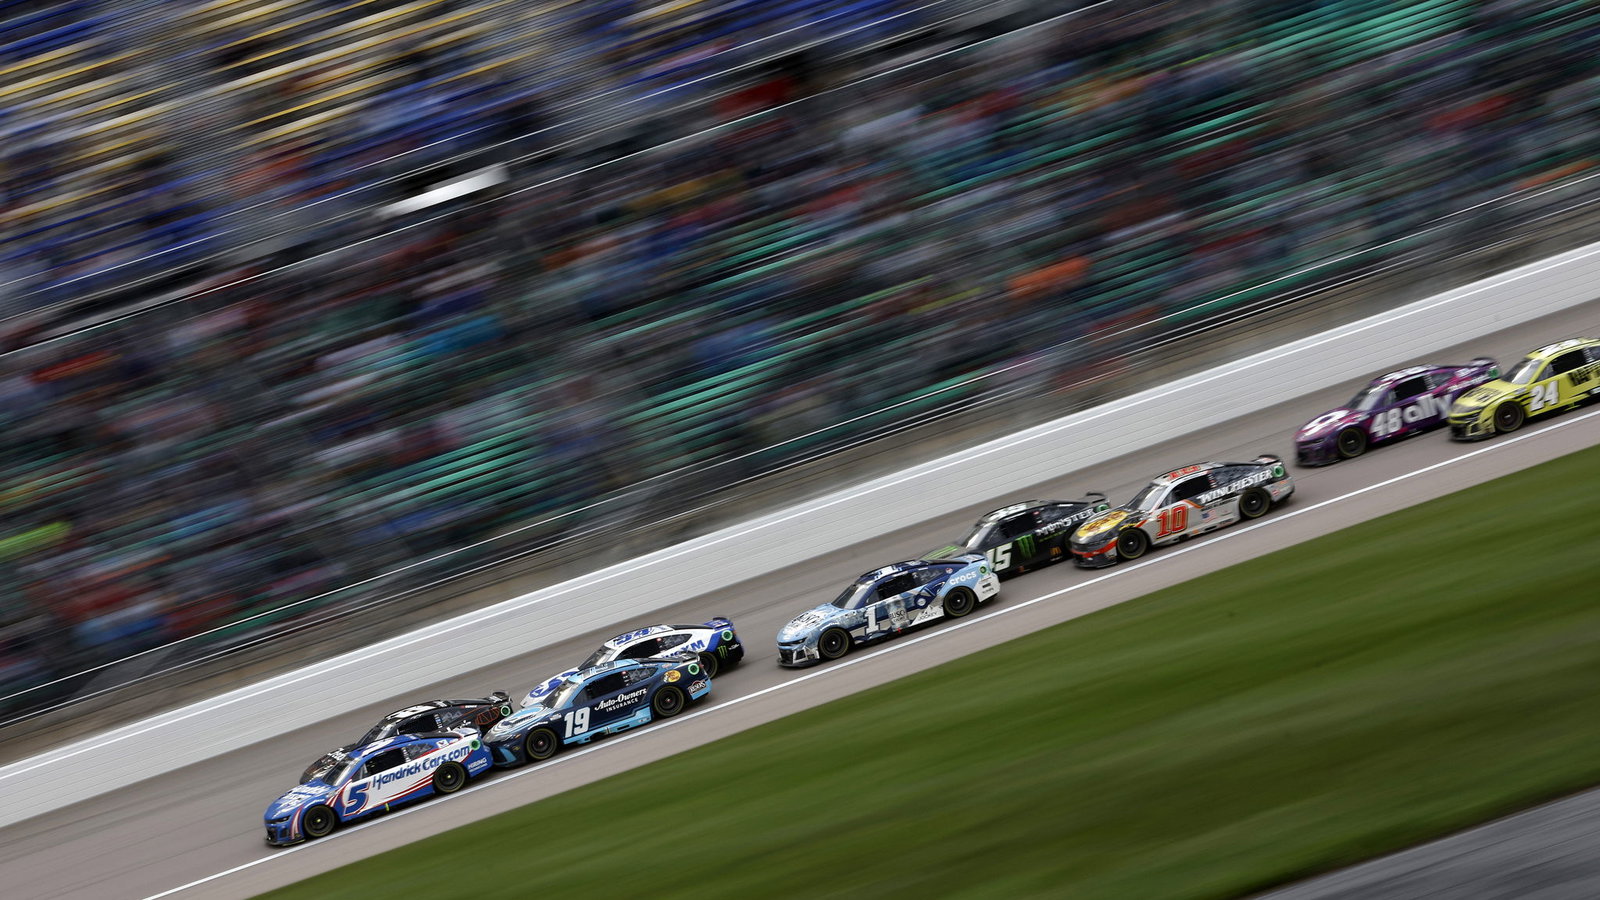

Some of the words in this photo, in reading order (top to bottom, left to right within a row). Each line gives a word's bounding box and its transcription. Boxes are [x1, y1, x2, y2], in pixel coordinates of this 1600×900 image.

[1530, 380, 1559, 411] 24
[1369, 408, 1403, 437] 48
[1197, 467, 1273, 503] WINCHESTER
[1156, 505, 1189, 538] 10
[950, 571, 977, 585] crocs
[864, 605, 881, 633] 1
[594, 687, 647, 711] Auto-Owners
[606, 697, 639, 713] INSURANCE
[564, 707, 590, 738] 19
[345, 782, 369, 815] 5
